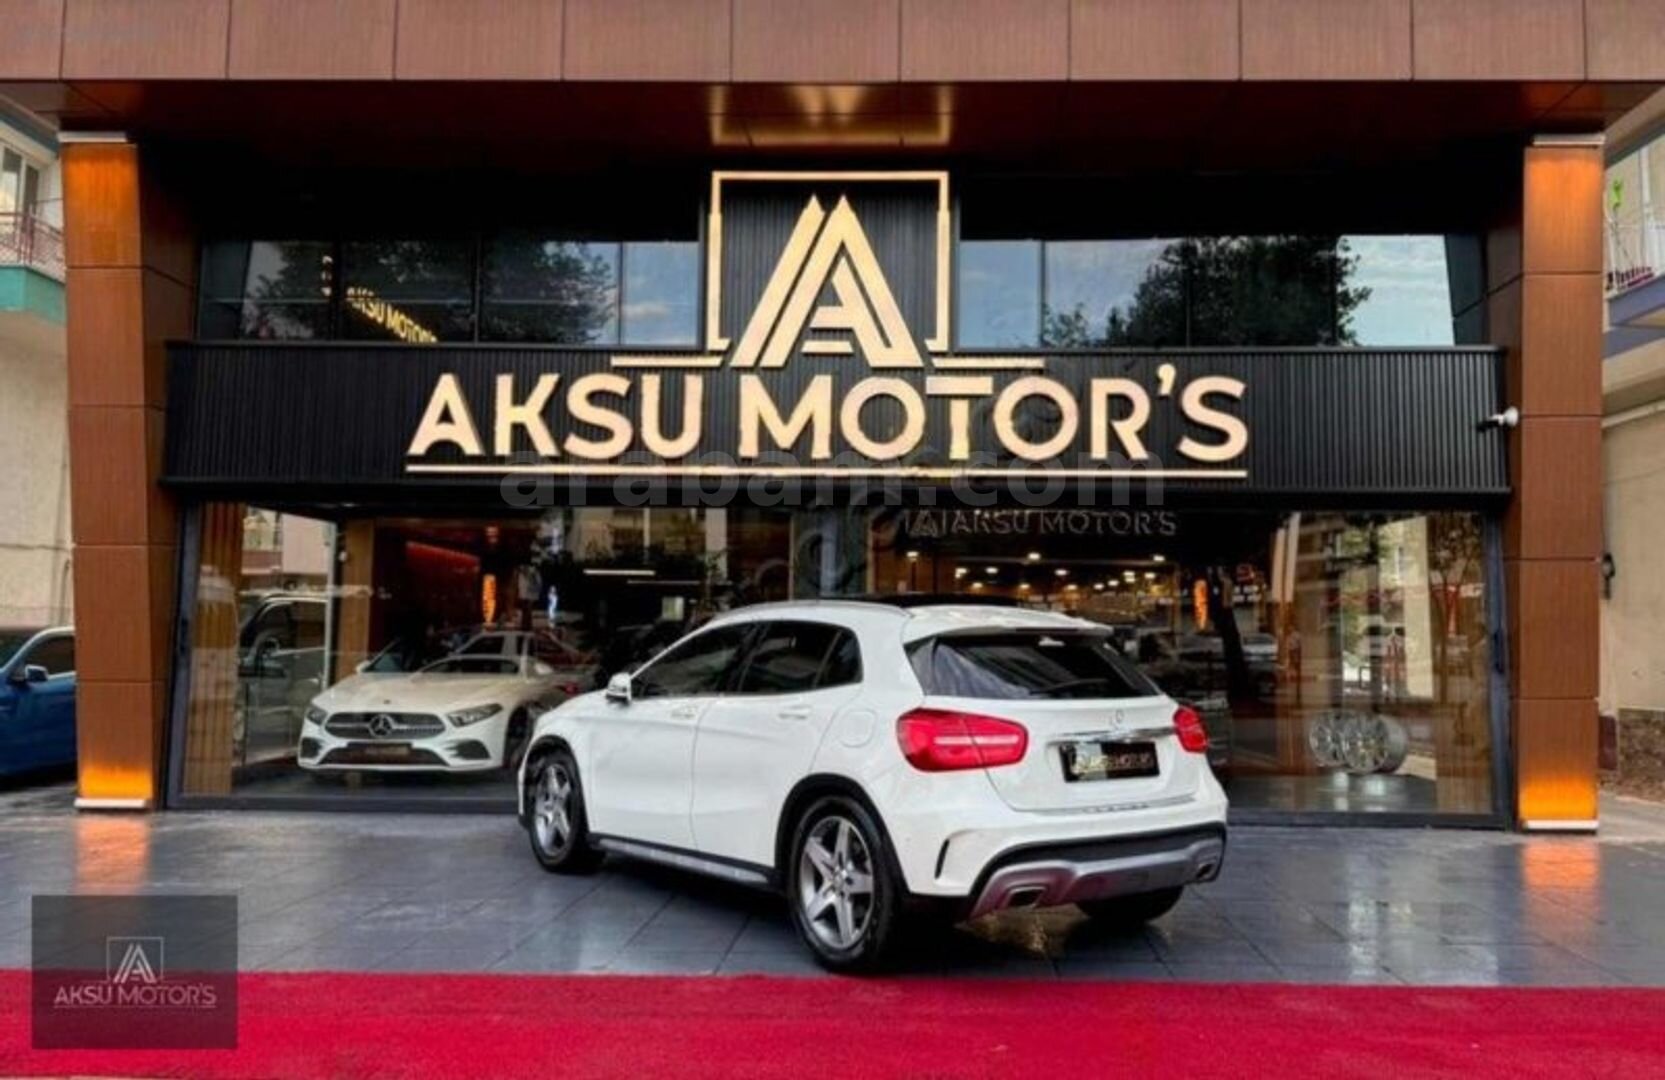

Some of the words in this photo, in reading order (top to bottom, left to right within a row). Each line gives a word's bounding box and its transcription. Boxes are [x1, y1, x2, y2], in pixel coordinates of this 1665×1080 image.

[407, 373, 702, 459] AKSU
[738, 363, 1248, 463] MOTOR'S
[951, 509, 1031, 536] AKSU
[1039, 509, 1177, 536] MOTOR'S
